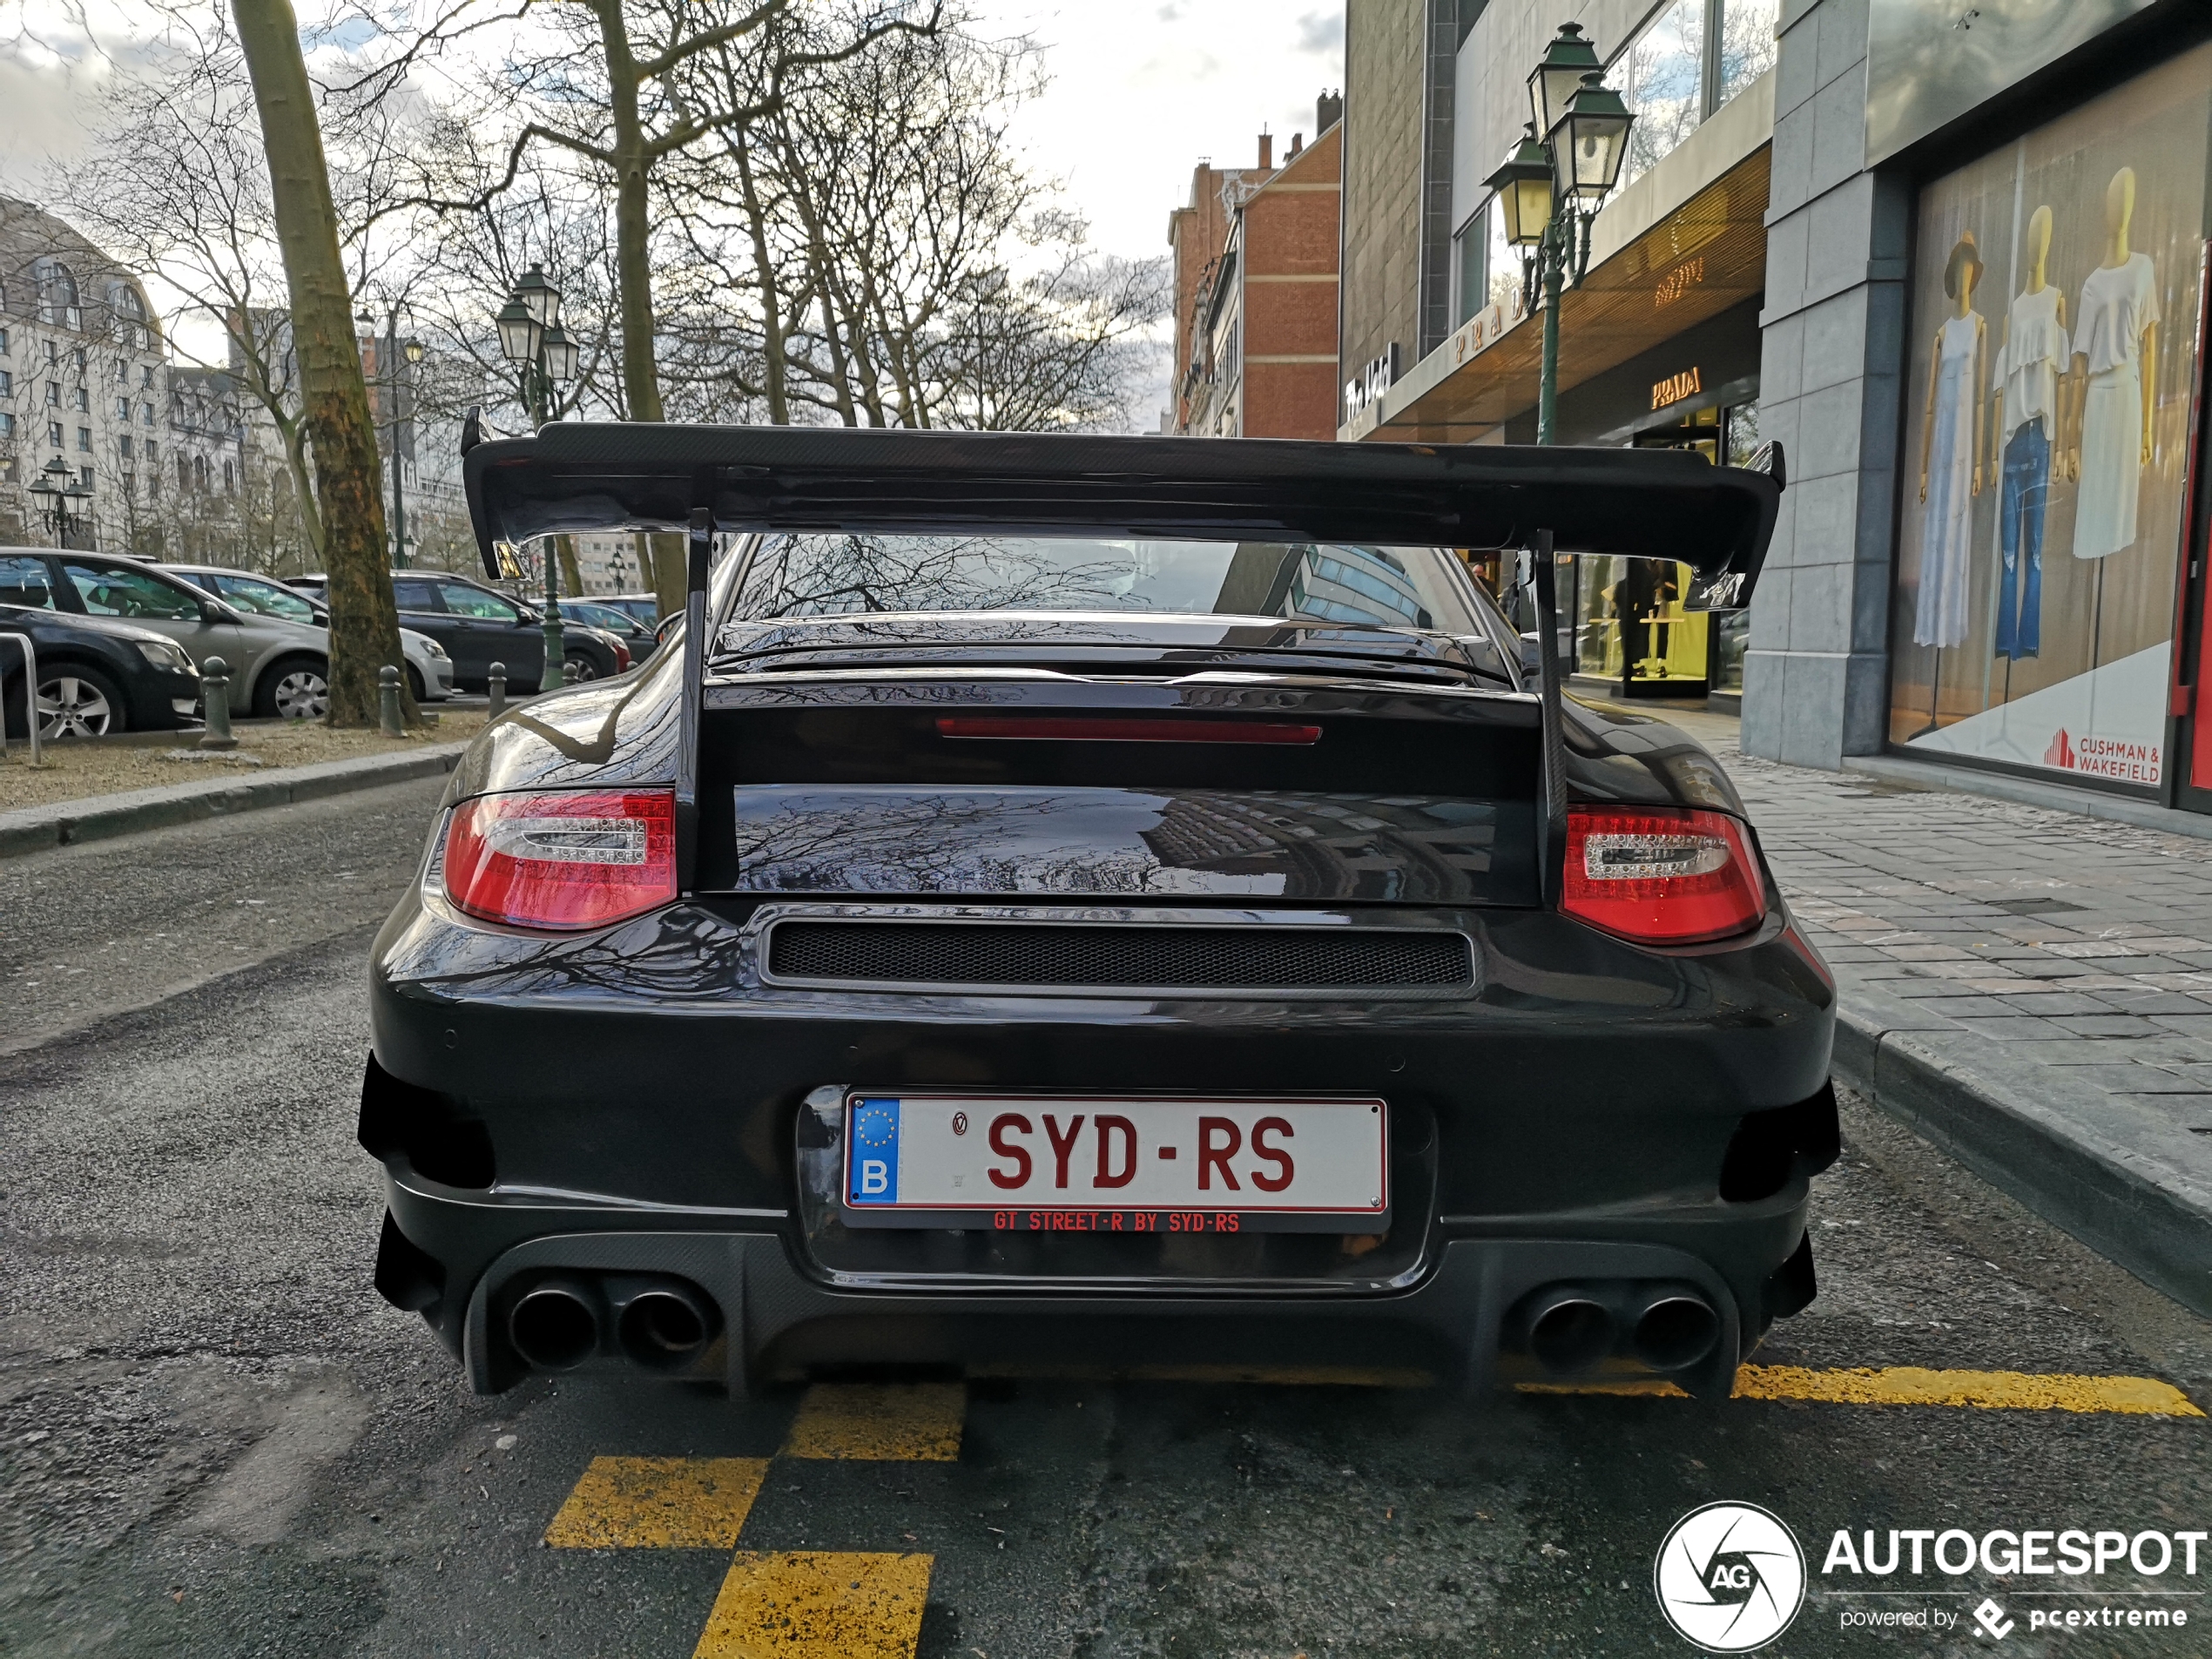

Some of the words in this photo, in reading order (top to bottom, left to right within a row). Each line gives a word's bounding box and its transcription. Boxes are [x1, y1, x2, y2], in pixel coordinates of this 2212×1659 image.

[1455, 283, 1546, 363] PRAD
[1651, 366, 1701, 410] PRADA
[2080, 738, 2147, 762] CUSHMAN
[2150, 747, 2160, 764] &
[2079, 756, 2159, 782] WAKEFIELD
[988, 1112, 1295, 1192] SYD-RS
[861, 1159, 888, 1194] B
[994, 1211, 1017, 1230] GT
[1028, 1211, 1123, 1231] STREET-R
[1134, 1212, 1157, 1231] BY
[1169, 1213, 1240, 1232] SYD-RS
